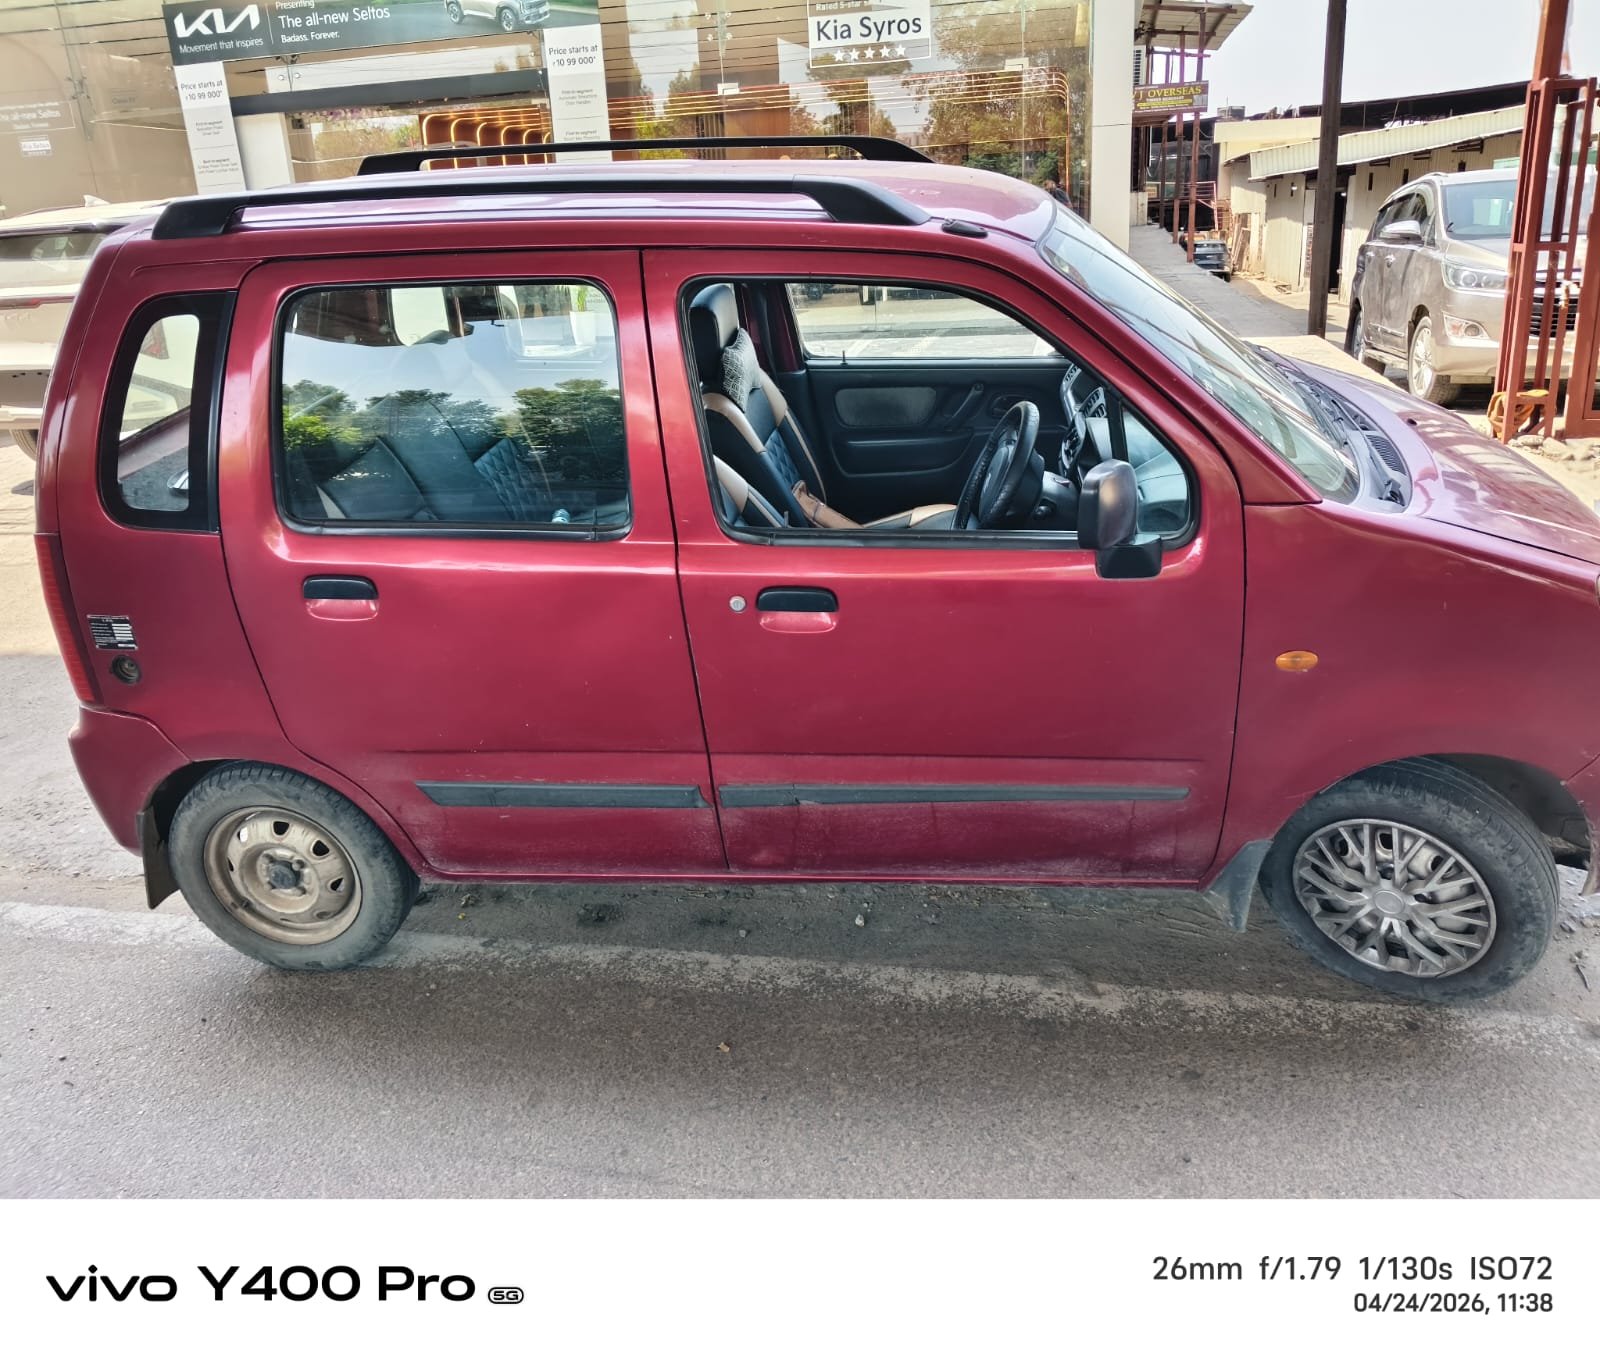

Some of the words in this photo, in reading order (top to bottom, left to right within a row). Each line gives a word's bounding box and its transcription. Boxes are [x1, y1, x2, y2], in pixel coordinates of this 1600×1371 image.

[275, 0, 315, 10] Presenting
[815, 2, 838, 11] Rated
[173, 4, 260, 38] KIA
[278, 15, 302, 29] The
[305, 11, 349, 27] all-new
[352, 5, 391, 21] Seltos
[816, 19, 852, 41] Kia
[859, 16, 922, 42] Syros
[281, 33, 309, 44] Badass.
[310, 31, 340, 41] Forever.
[179, 42, 218, 54] Movement
[219, 39, 234, 50] that
[235, 37, 263, 49] inspires
[548, 47, 567, 55] Price
[568, 45, 589, 54] starts
[590, 44, 598, 52] at
[566, 58, 576, 66] 99
[198, 80, 216, 89] starts
[1147, 85, 1202, 98] OVERSEAS
